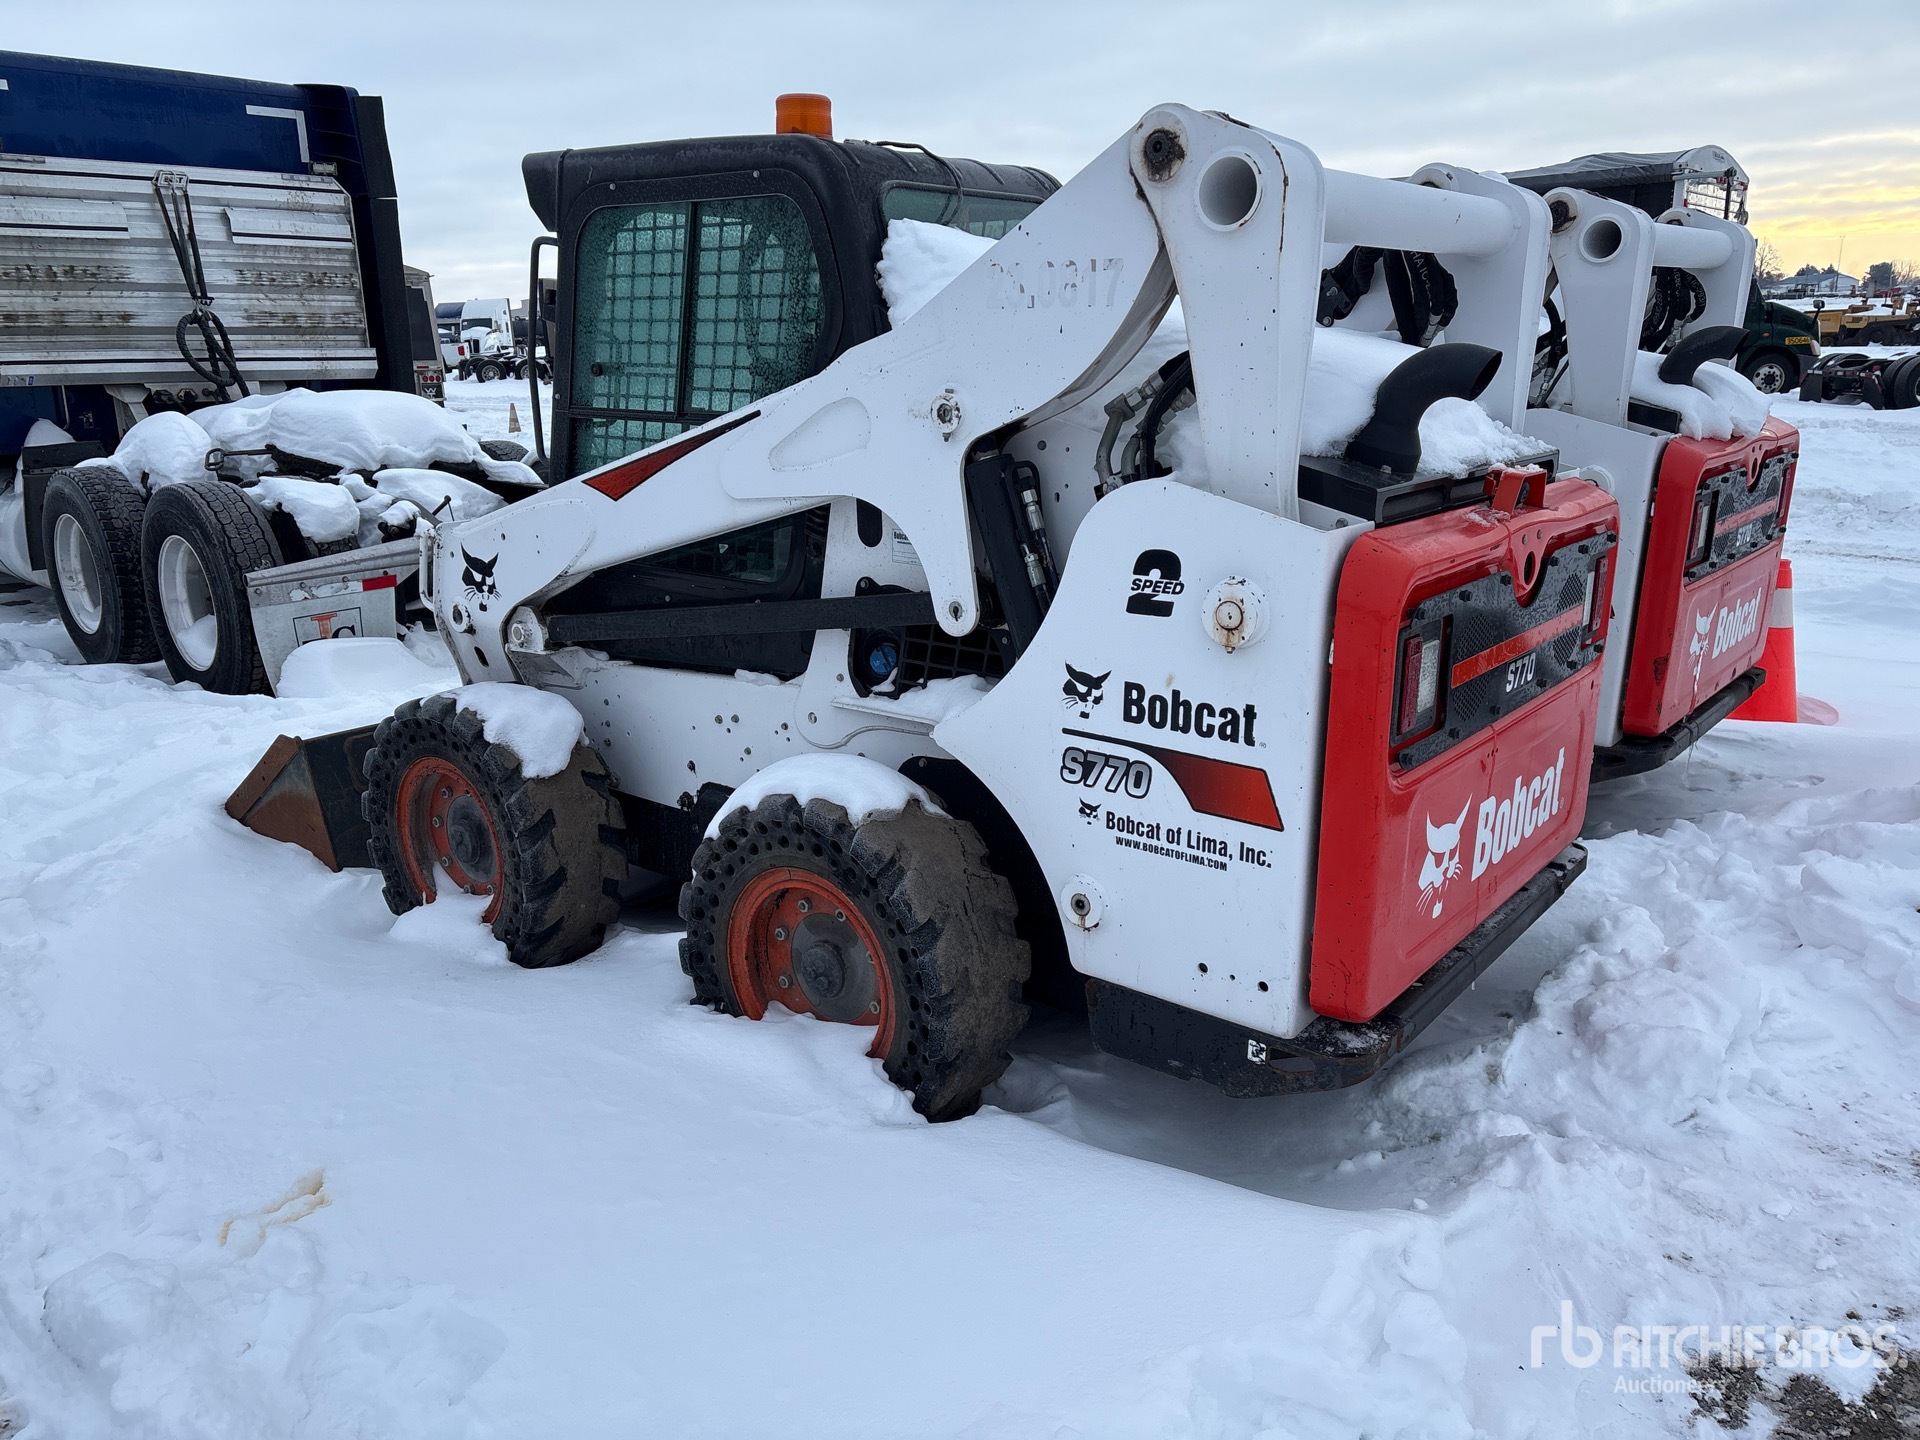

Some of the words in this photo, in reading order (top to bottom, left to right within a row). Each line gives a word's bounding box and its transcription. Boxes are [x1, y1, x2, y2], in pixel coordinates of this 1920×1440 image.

[1125, 549, 1182, 617] 2
[1130, 578, 1185, 595] SPEED
[1712, 587, 1762, 659] Bobcat
[1506, 652, 1536, 693] S770
[1123, 681, 1257, 747] Bobcat
[1060, 746, 1152, 799] S770
[1106, 811, 1161, 841] Bobcat
[1166, 827, 1182, 846] of
[1186, 829, 1233, 861] Lima,
[1239, 841, 1272, 868] Inc.
[1471, 747, 1565, 882] Bobcat
[1115, 836, 1227, 872] WWW.BOBCATOFLIMA.COM
